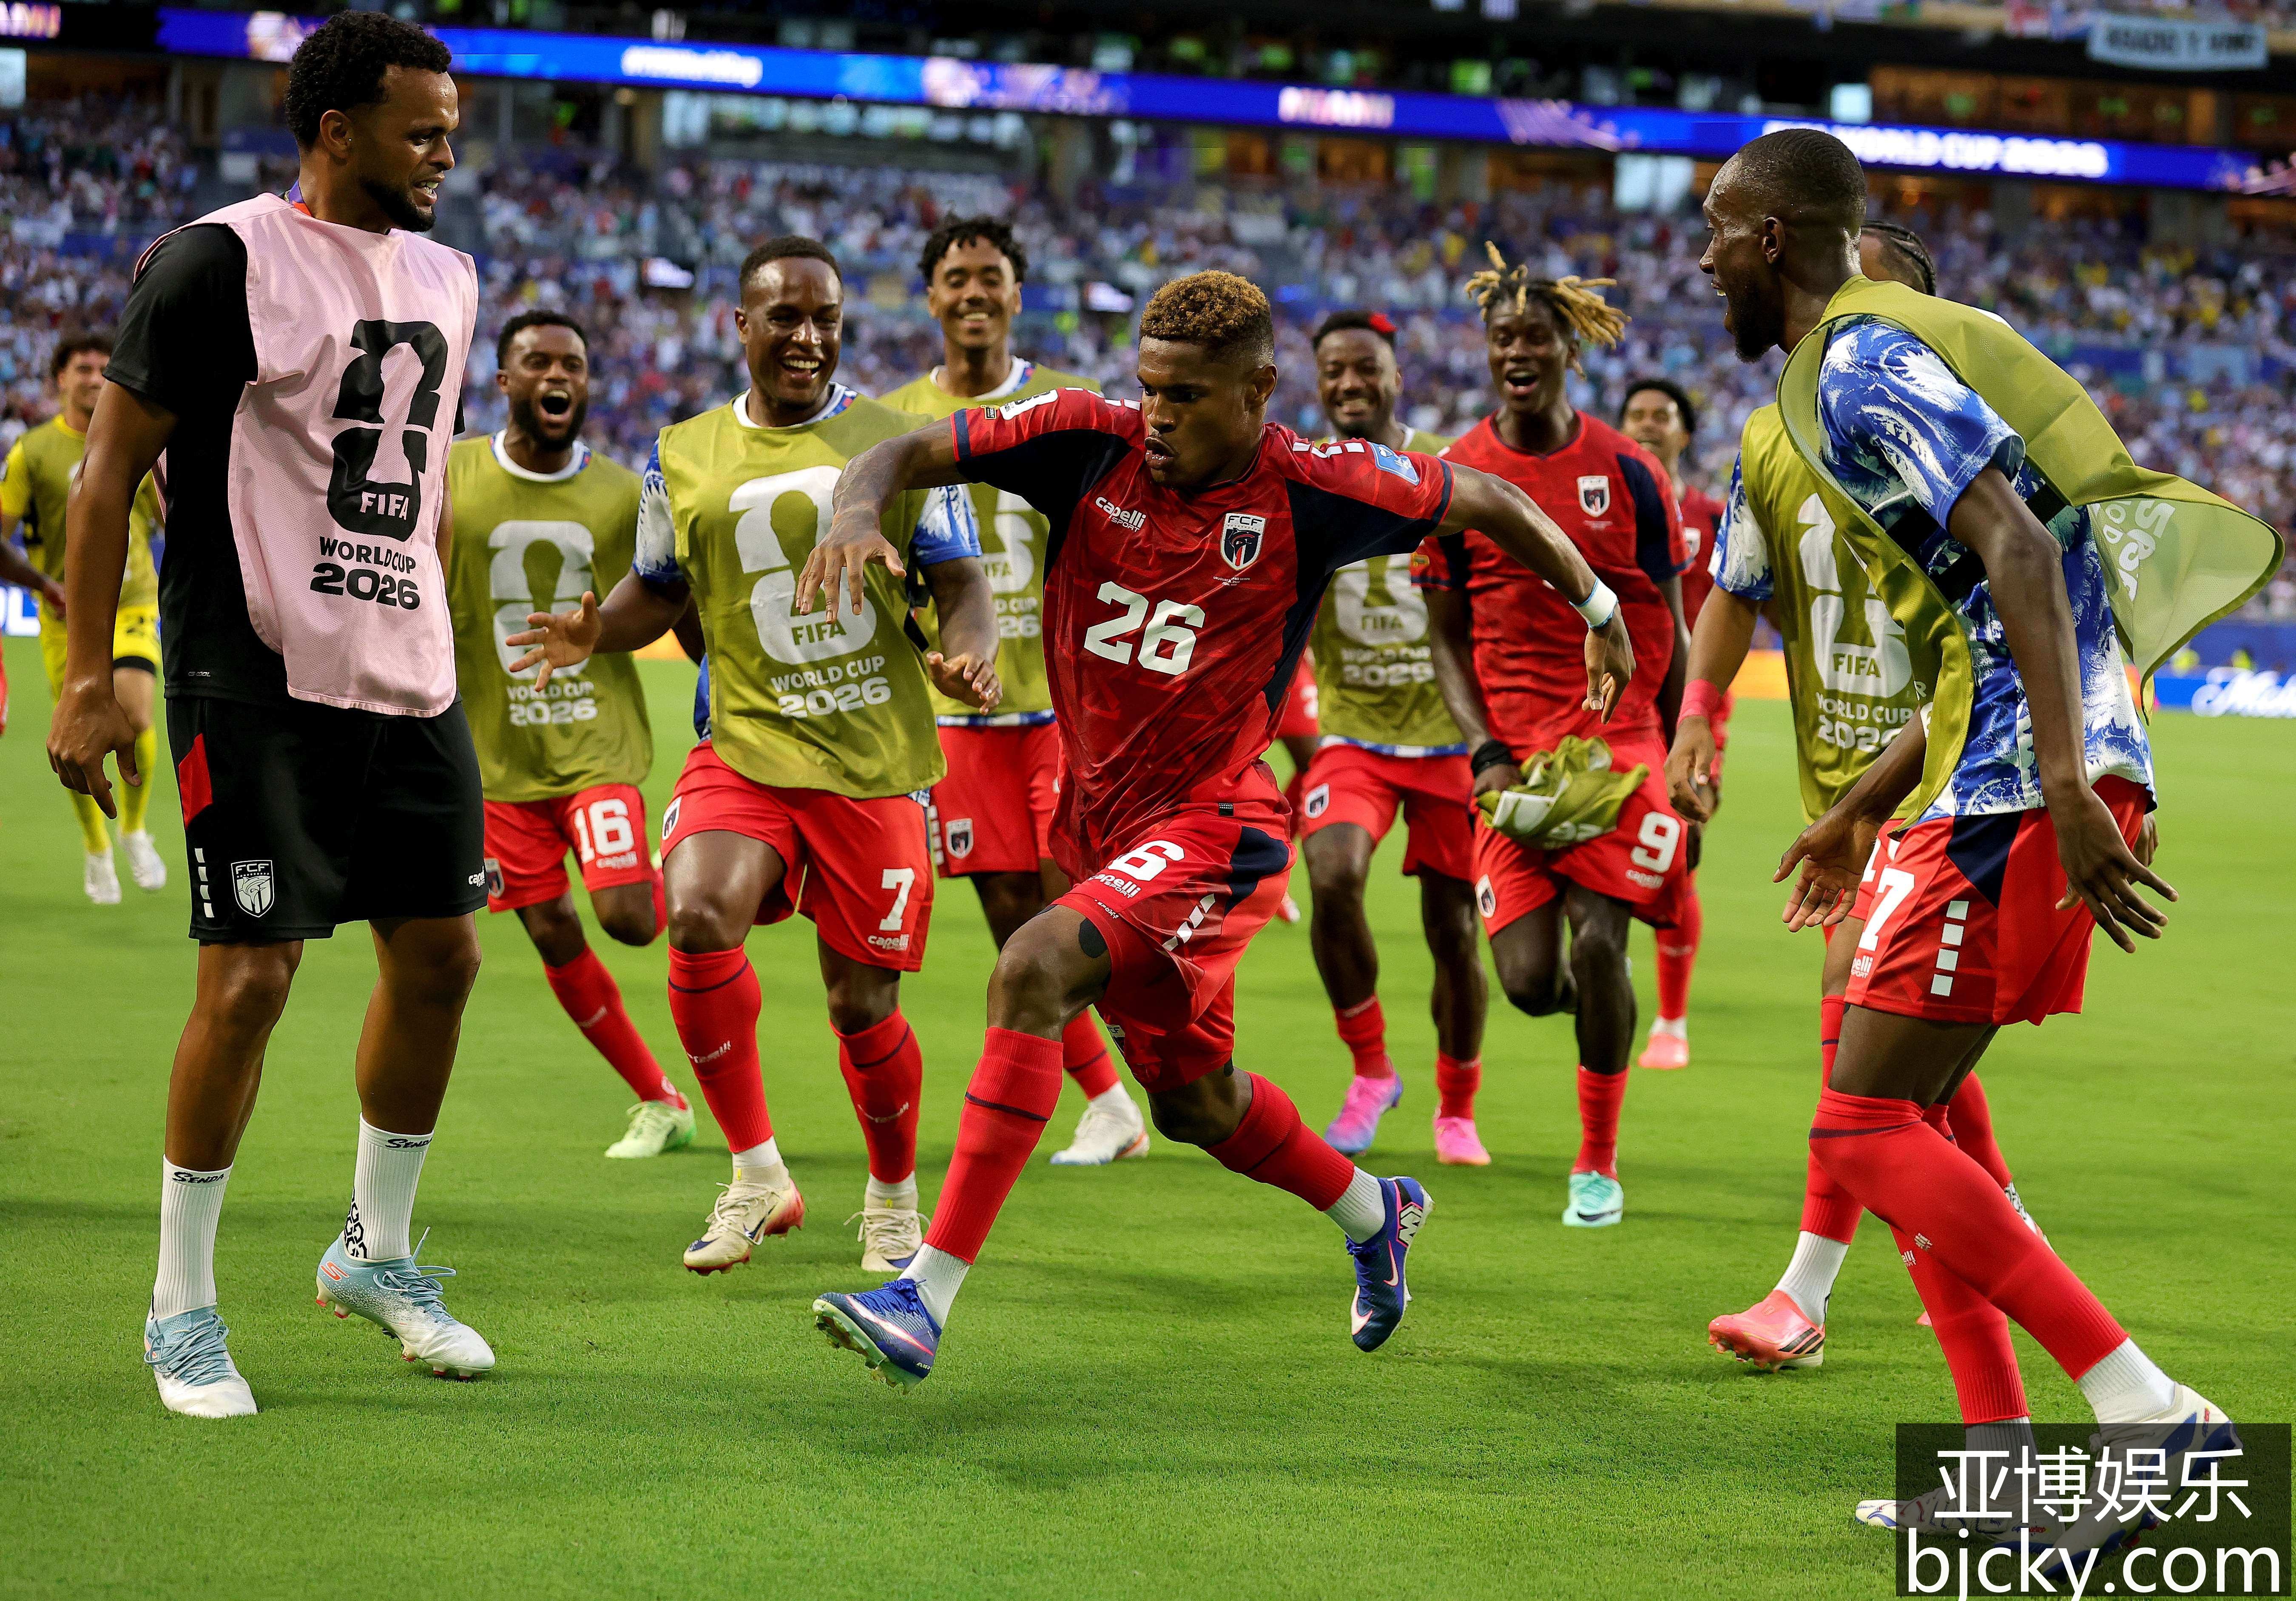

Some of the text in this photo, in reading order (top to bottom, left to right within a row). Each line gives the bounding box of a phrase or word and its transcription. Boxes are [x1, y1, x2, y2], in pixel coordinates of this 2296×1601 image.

[359, 490, 409, 521] FIFA
[1095, 497, 1146, 528] capelli
[1228, 515, 1262, 526] FCF
[1111, 517, 1140, 532] SPORT
[310, 562, 420, 610] 2026
[792, 621, 847, 645] FIFA
[998, 615, 1040, 638] 26
[1083, 581, 1205, 676] 26
[1362, 616, 1404, 630] FIFA
[771, 655, 886, 692] WORLD CUP
[1833, 652, 1881, 678] FIFA
[509, 697, 598, 727] 2026
[778, 676, 892, 718] 2026
[1816, 692, 1869, 722] WORLD
[1872, 705, 1914, 725] CUP
[574, 798, 635, 864] 16
[1631, 811, 1681, 873] 9
[236, 863, 269, 874] FCF
[878, 867, 916, 931] 7
[1103, 881, 1133, 899] SPORT
[1857, 863, 1915, 952] 7
[172, 1171, 224, 1184] SENDA
